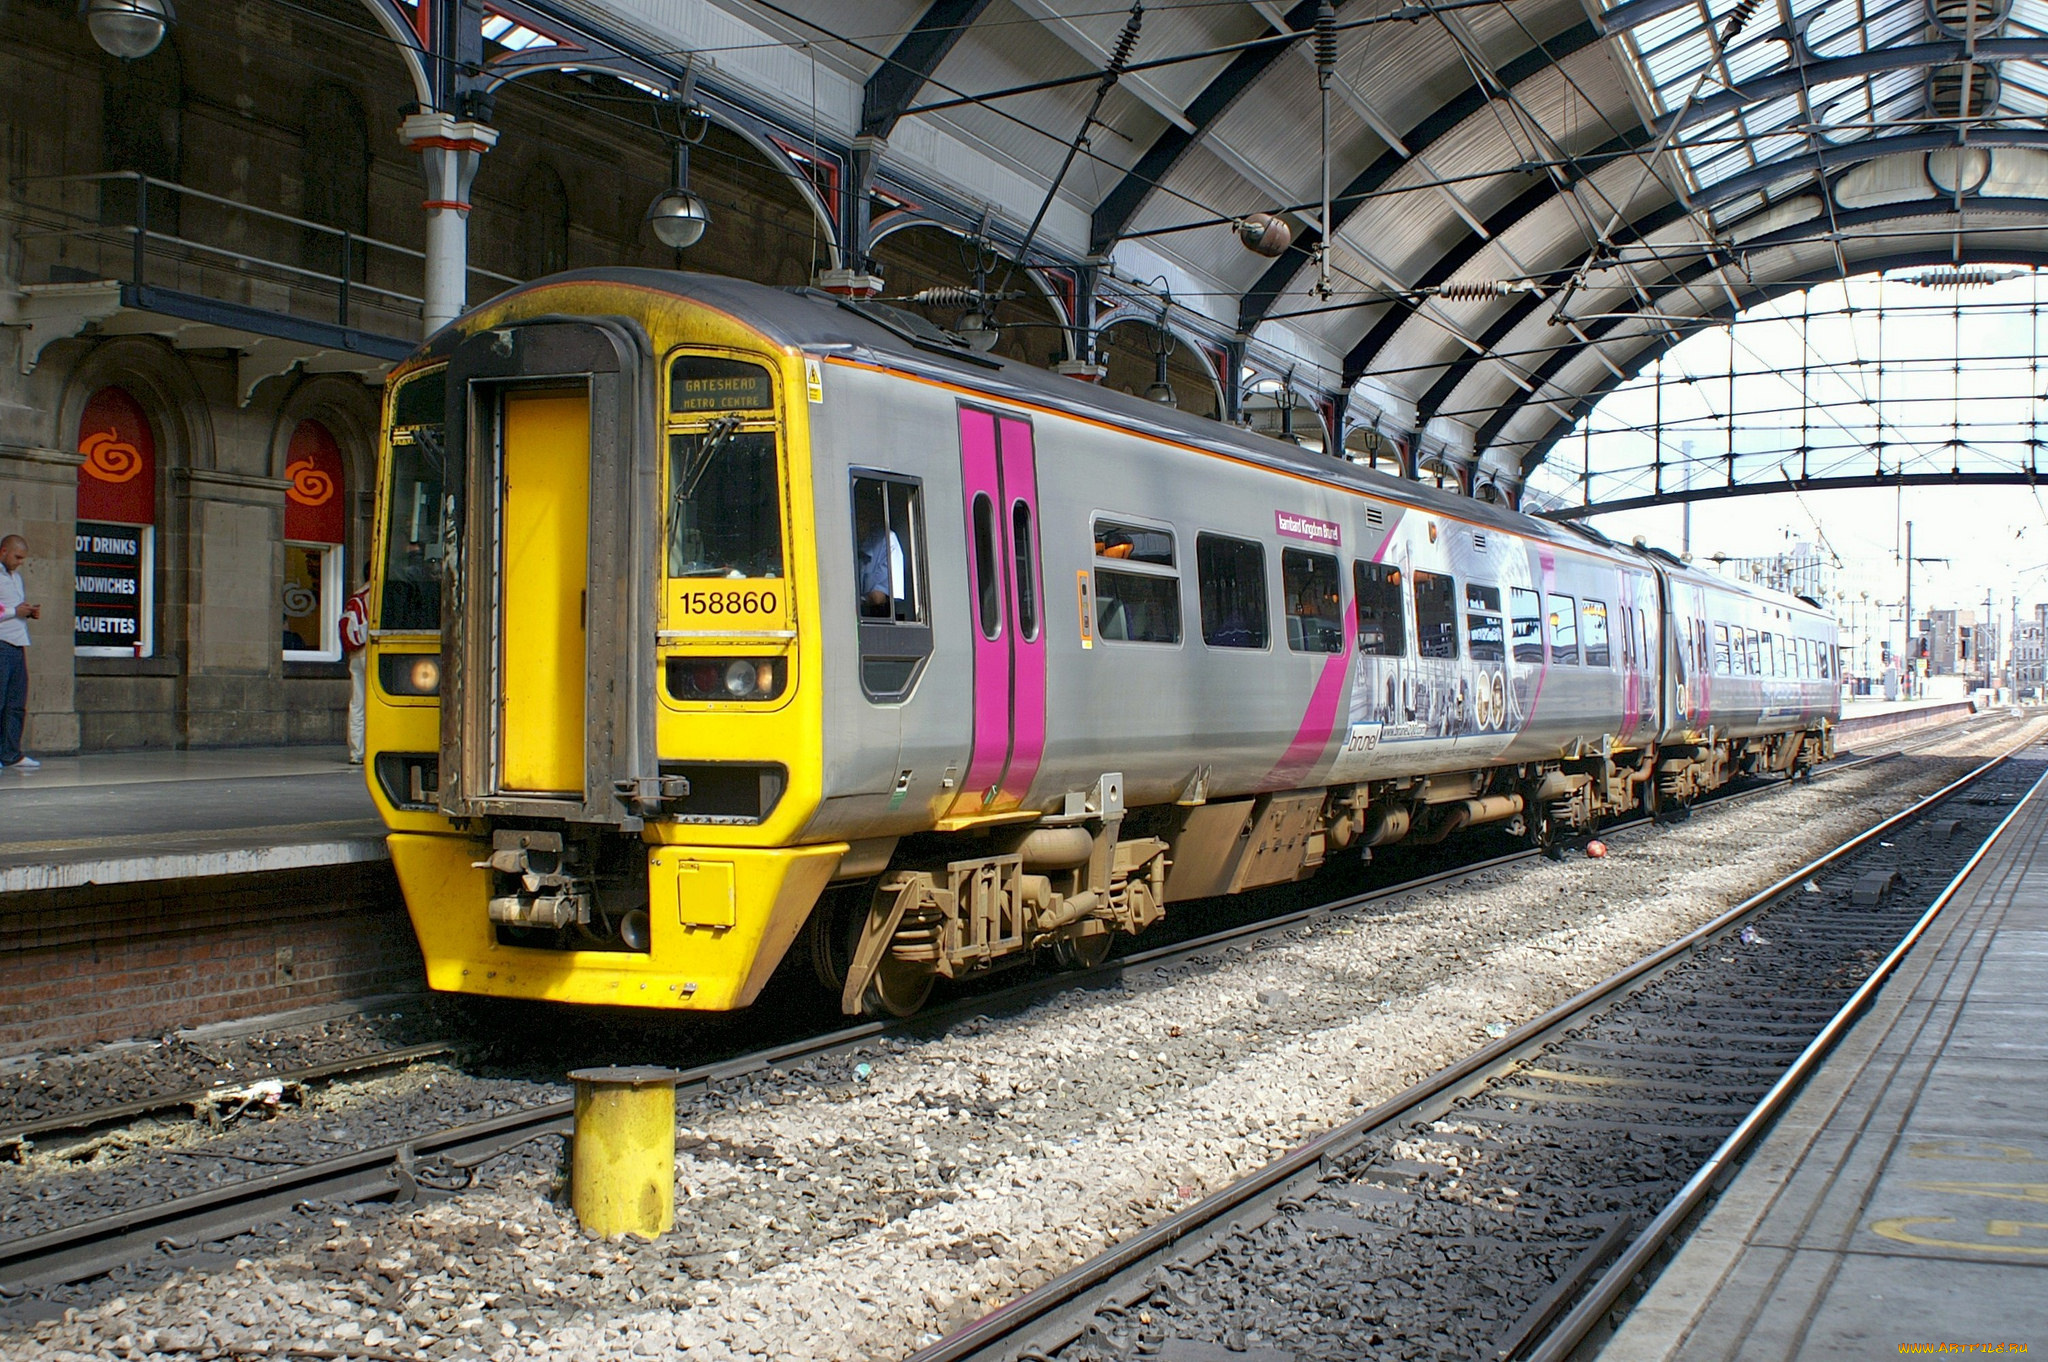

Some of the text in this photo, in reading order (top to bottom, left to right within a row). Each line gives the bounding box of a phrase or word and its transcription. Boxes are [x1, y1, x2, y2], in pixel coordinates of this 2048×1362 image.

[686, 378, 756, 392] GATESHEAD
[684, 396, 759, 409] METRO CENTRE
[1302, 519, 1323, 539] Kingdom
[1323, 524, 1338, 540] Brunel
[75, 535, 137, 556] OT DRINKS
[75, 576, 135, 594] ANDWICHES
[680, 592, 777, 614] 158860
[75, 616, 135, 634] AGUETTES
[1348, 729, 1379, 752] brunel
